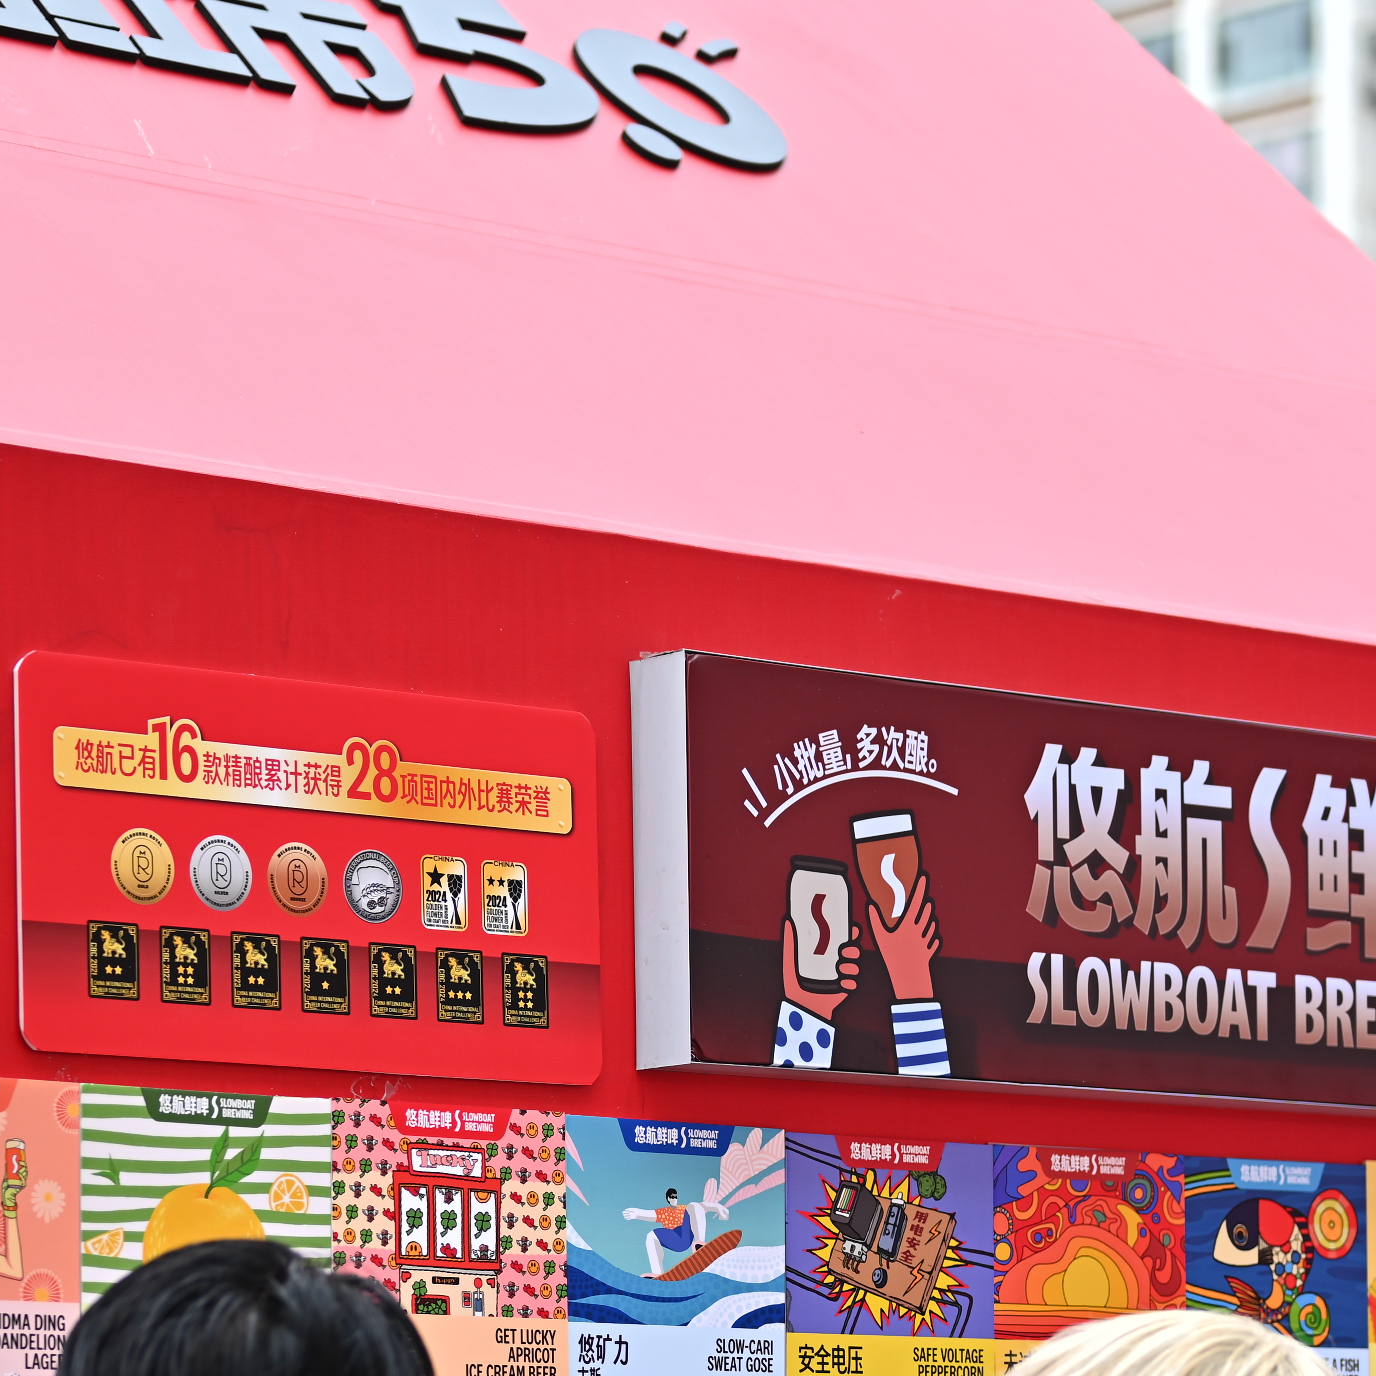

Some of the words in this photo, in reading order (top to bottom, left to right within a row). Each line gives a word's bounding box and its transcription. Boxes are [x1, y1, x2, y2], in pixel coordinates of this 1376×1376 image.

[433, 855, 455, 863] CHINA
[493, 860, 515, 868] CHINA
[425, 889, 448, 903] 2024
[486, 895, 508, 908] 2024
[1026, 951, 1277, 1043] SLOWBOAT
[159, 1094, 210, 1116] 悠航鲜啤
[405, 1108, 453, 1130] 悠航鲜啤
[634, 1125, 679, 1146] 悠航鲜啤
[850, 1141, 892, 1162] 悠航鲜啤
[901, 1210, 929, 1265] 用电安全
[34, 1315, 66, 1332] DING
[495, 1328, 517, 1346] GET
[519, 1328, 557, 1347] LUCKY
[508, 1346, 556, 1364] APRICOT
[578, 1333, 629, 1366] 悠矿力
[715, 1338, 774, 1356] SLOW-CARI
[913, 1347, 938, 1363] SAFE
[940, 1348, 984, 1364] VOLTAGE
[707, 1355, 743, 1372] SWEAT
[746, 1357, 774, 1373] GOSE
[798, 1344, 864, 1375] 安全电压
[1340, 1358, 1360, 1372] FISH
